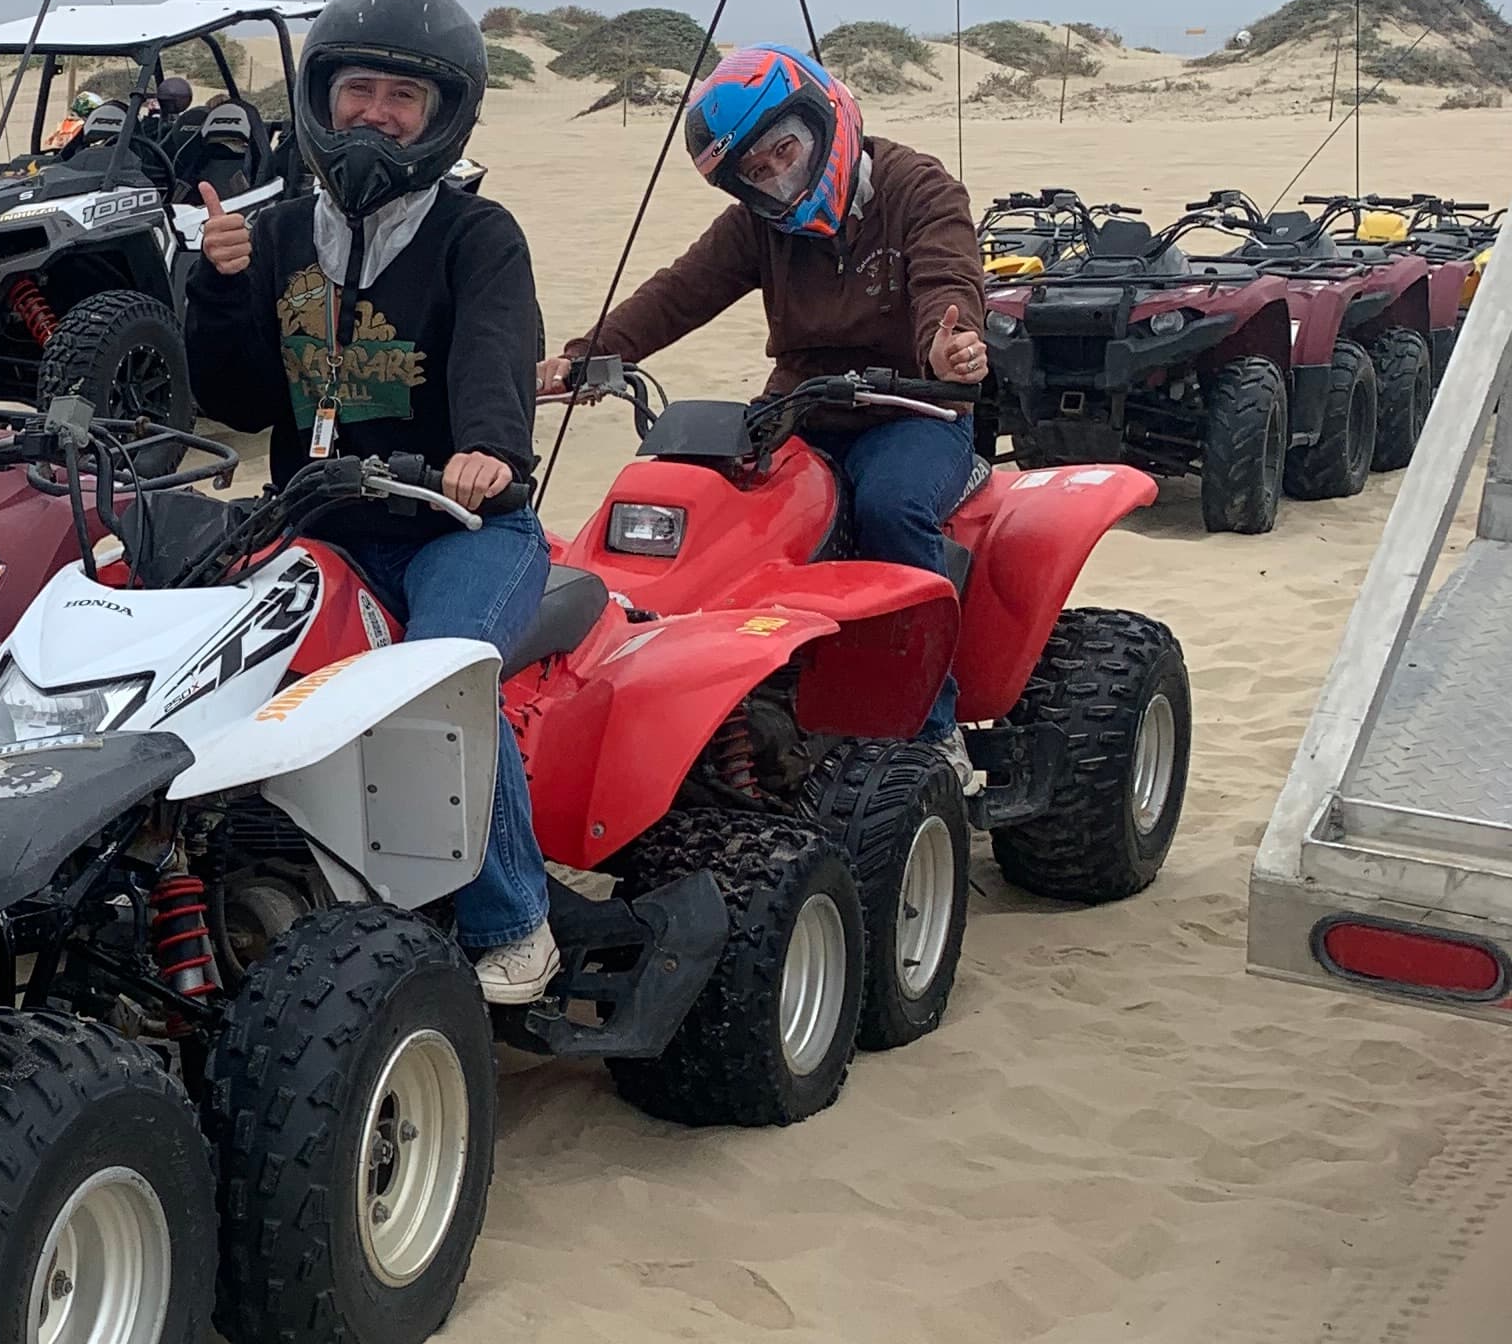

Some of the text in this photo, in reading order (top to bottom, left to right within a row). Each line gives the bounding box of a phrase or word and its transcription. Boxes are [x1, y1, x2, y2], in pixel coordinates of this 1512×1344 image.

[82, 191, 158, 225] 1000
[951, 462, 988, 512] NDA
[64, 599, 135, 618] HONDA
[164, 682, 201, 713] 250X
